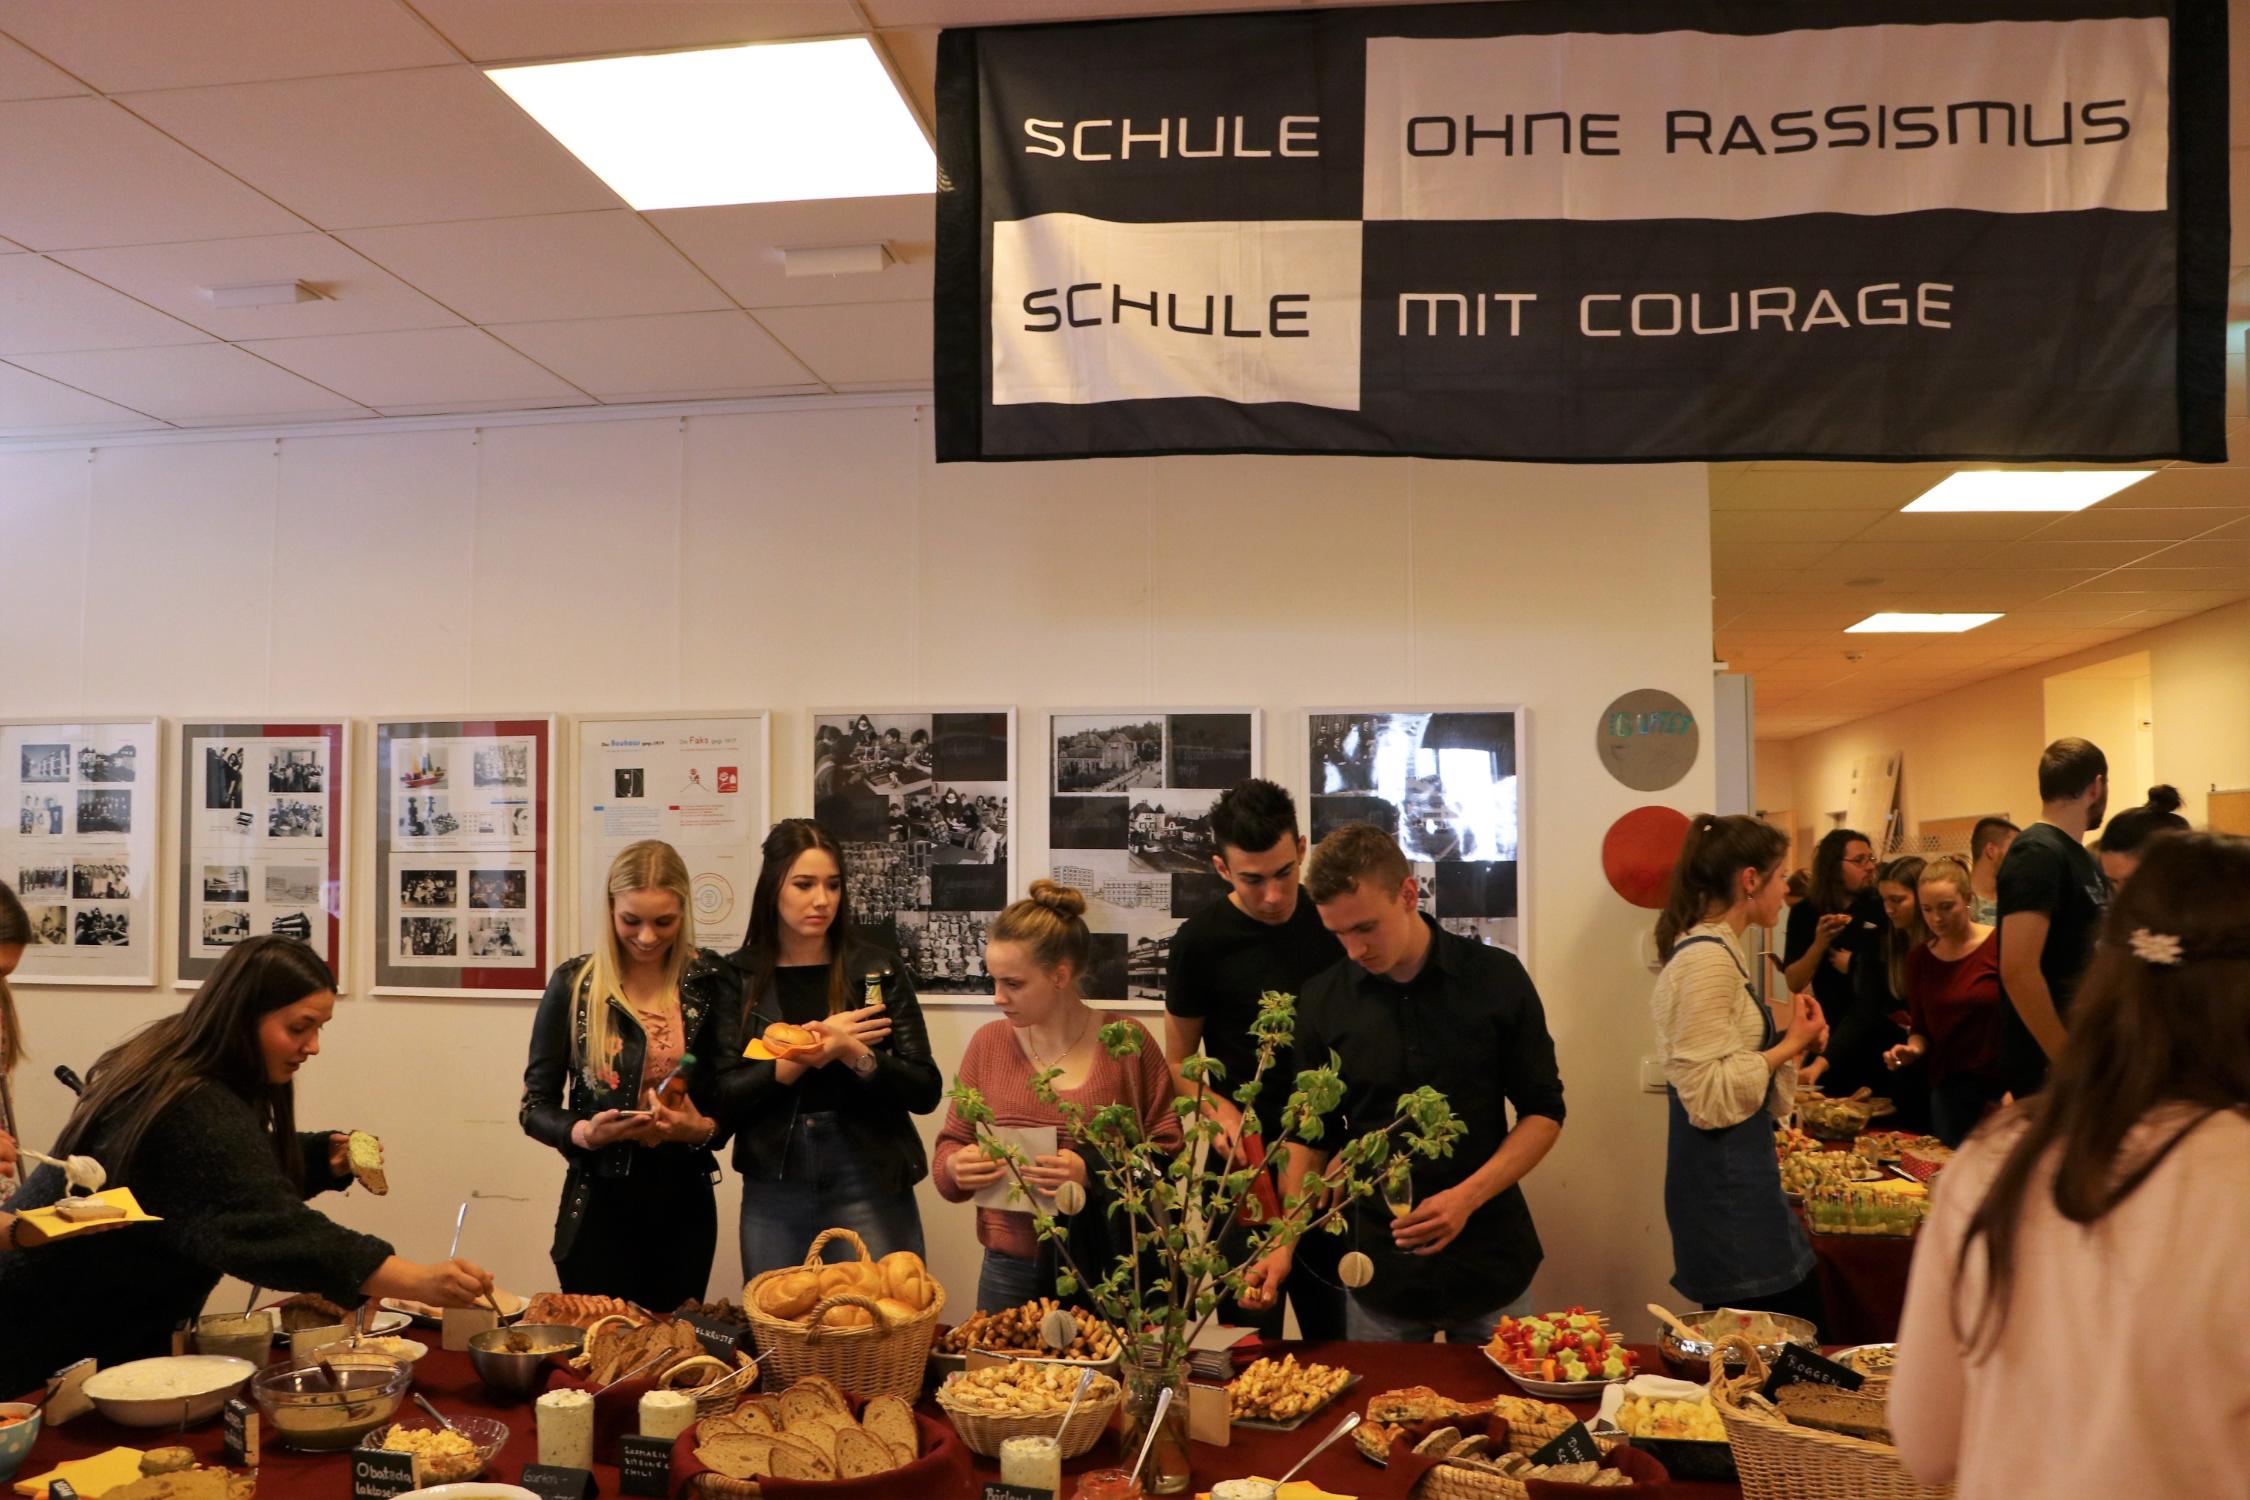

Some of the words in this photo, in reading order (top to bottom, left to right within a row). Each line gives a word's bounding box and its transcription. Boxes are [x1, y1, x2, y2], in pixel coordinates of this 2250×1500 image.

[1023, 115, 1320, 162] SCHULE
[1406, 112, 1621, 157] OHNE
[1665, 99, 2131, 156] RASSISMUS
[1022, 282, 1311, 339] SCHULE
[1398, 293, 1537, 337] MIT
[1580, 282, 1954, 337] COURAGE
[1787, 1354, 1841, 1387] ROGGEN
